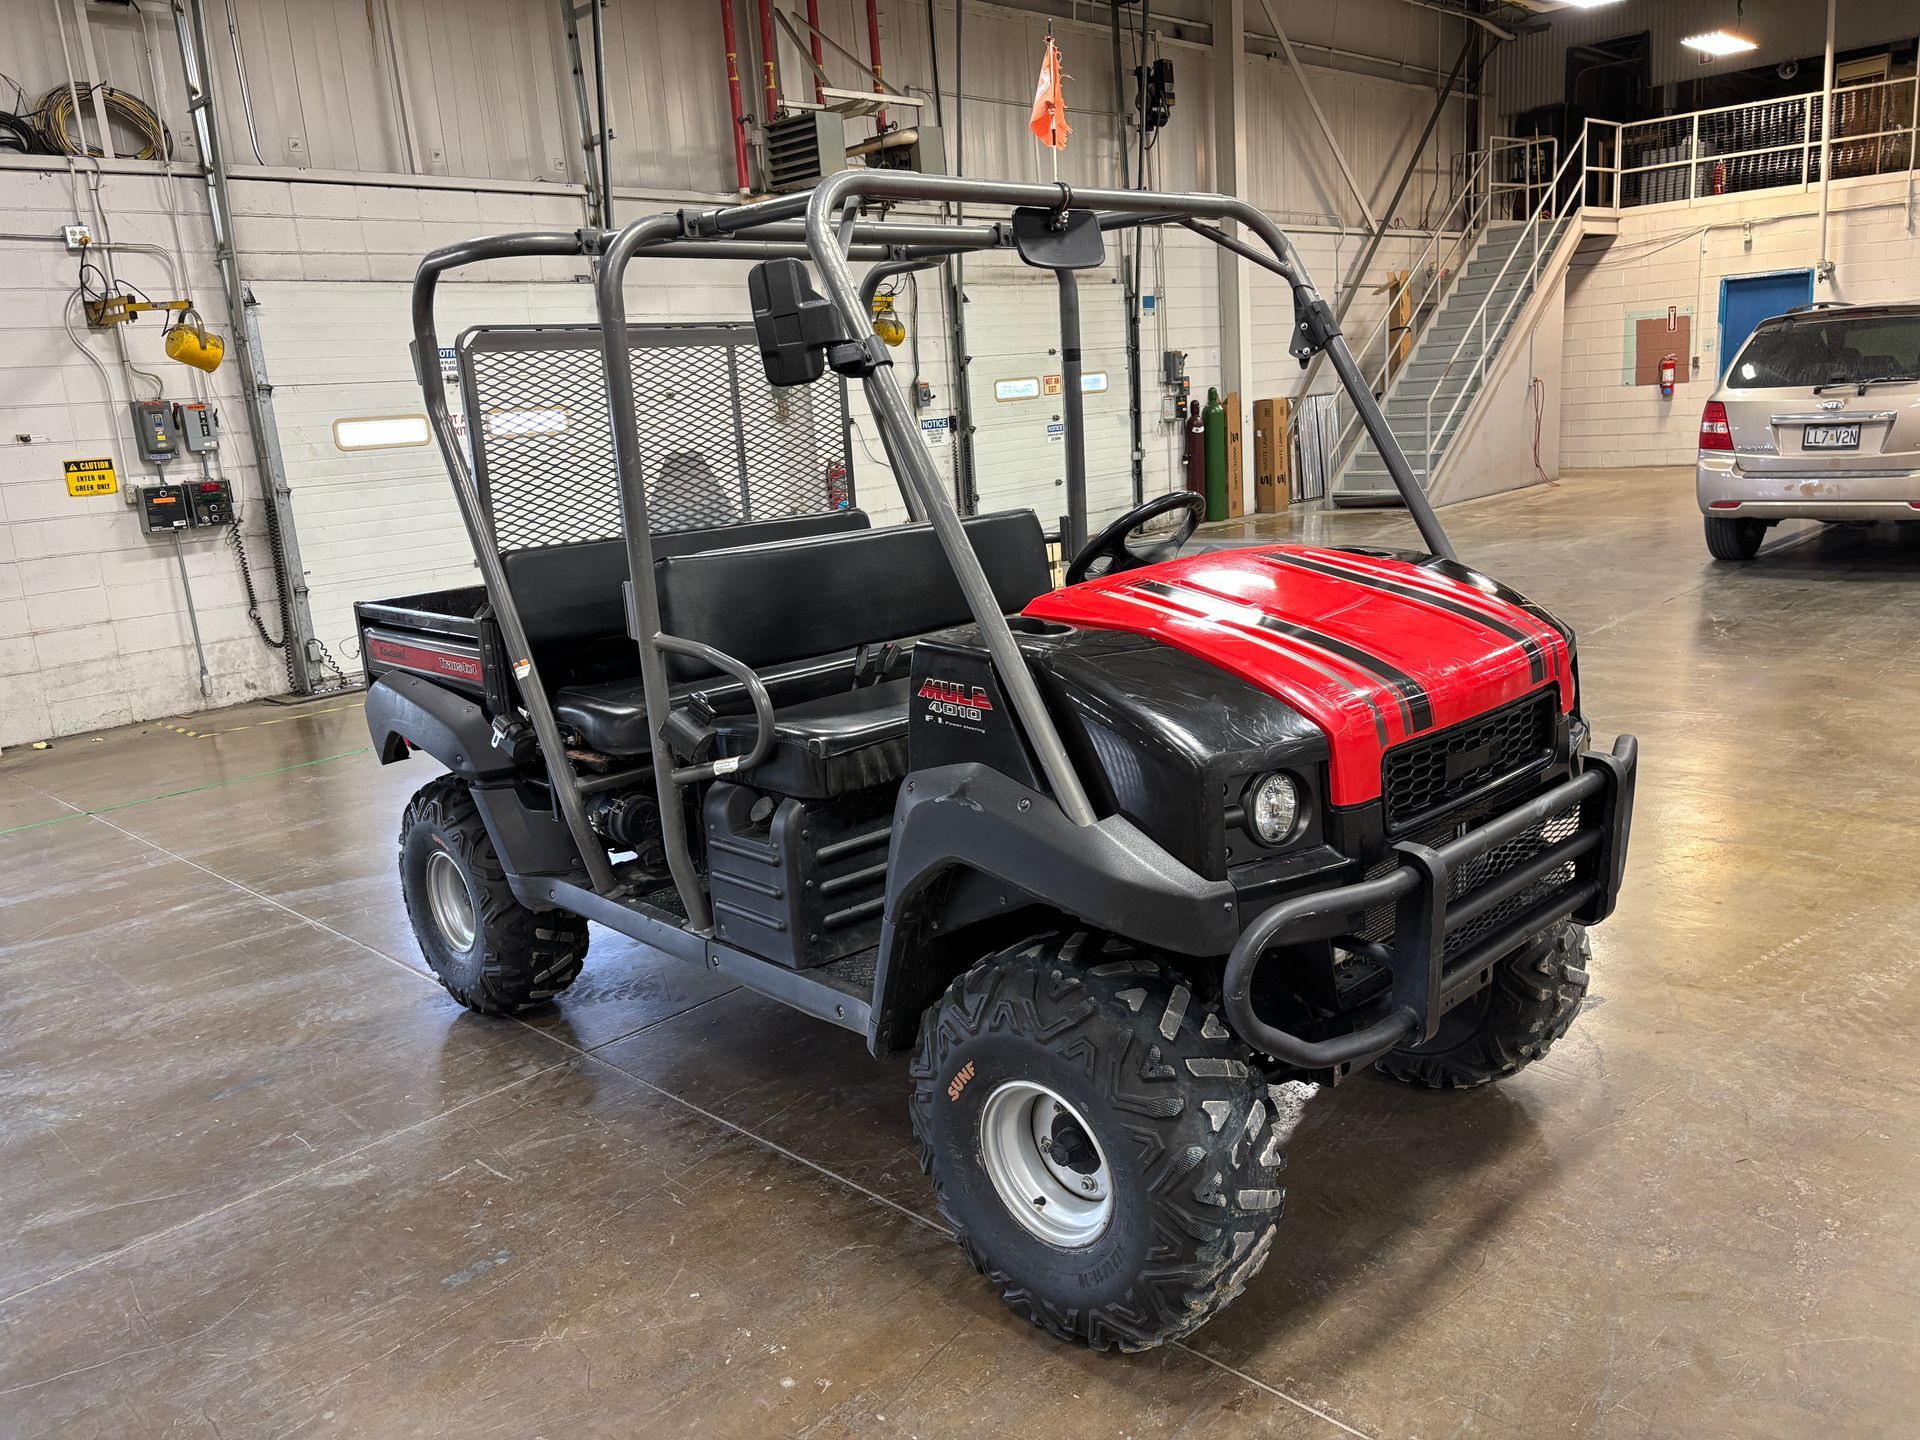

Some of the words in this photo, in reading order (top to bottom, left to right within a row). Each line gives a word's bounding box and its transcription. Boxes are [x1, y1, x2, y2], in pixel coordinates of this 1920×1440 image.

[922, 419, 948, 429] NOTICE
[1806, 430, 1828, 444] LL7
[1835, 430, 1858, 444] V2N
[80, 461, 110, 470] CAUTION
[76, 474, 96, 482] ENTER
[75, 484, 95, 492] GREEN
[917, 677, 993, 710] MULE
[928, 700, 981, 721] 4010
[947, 1060, 975, 1102] SUNF
